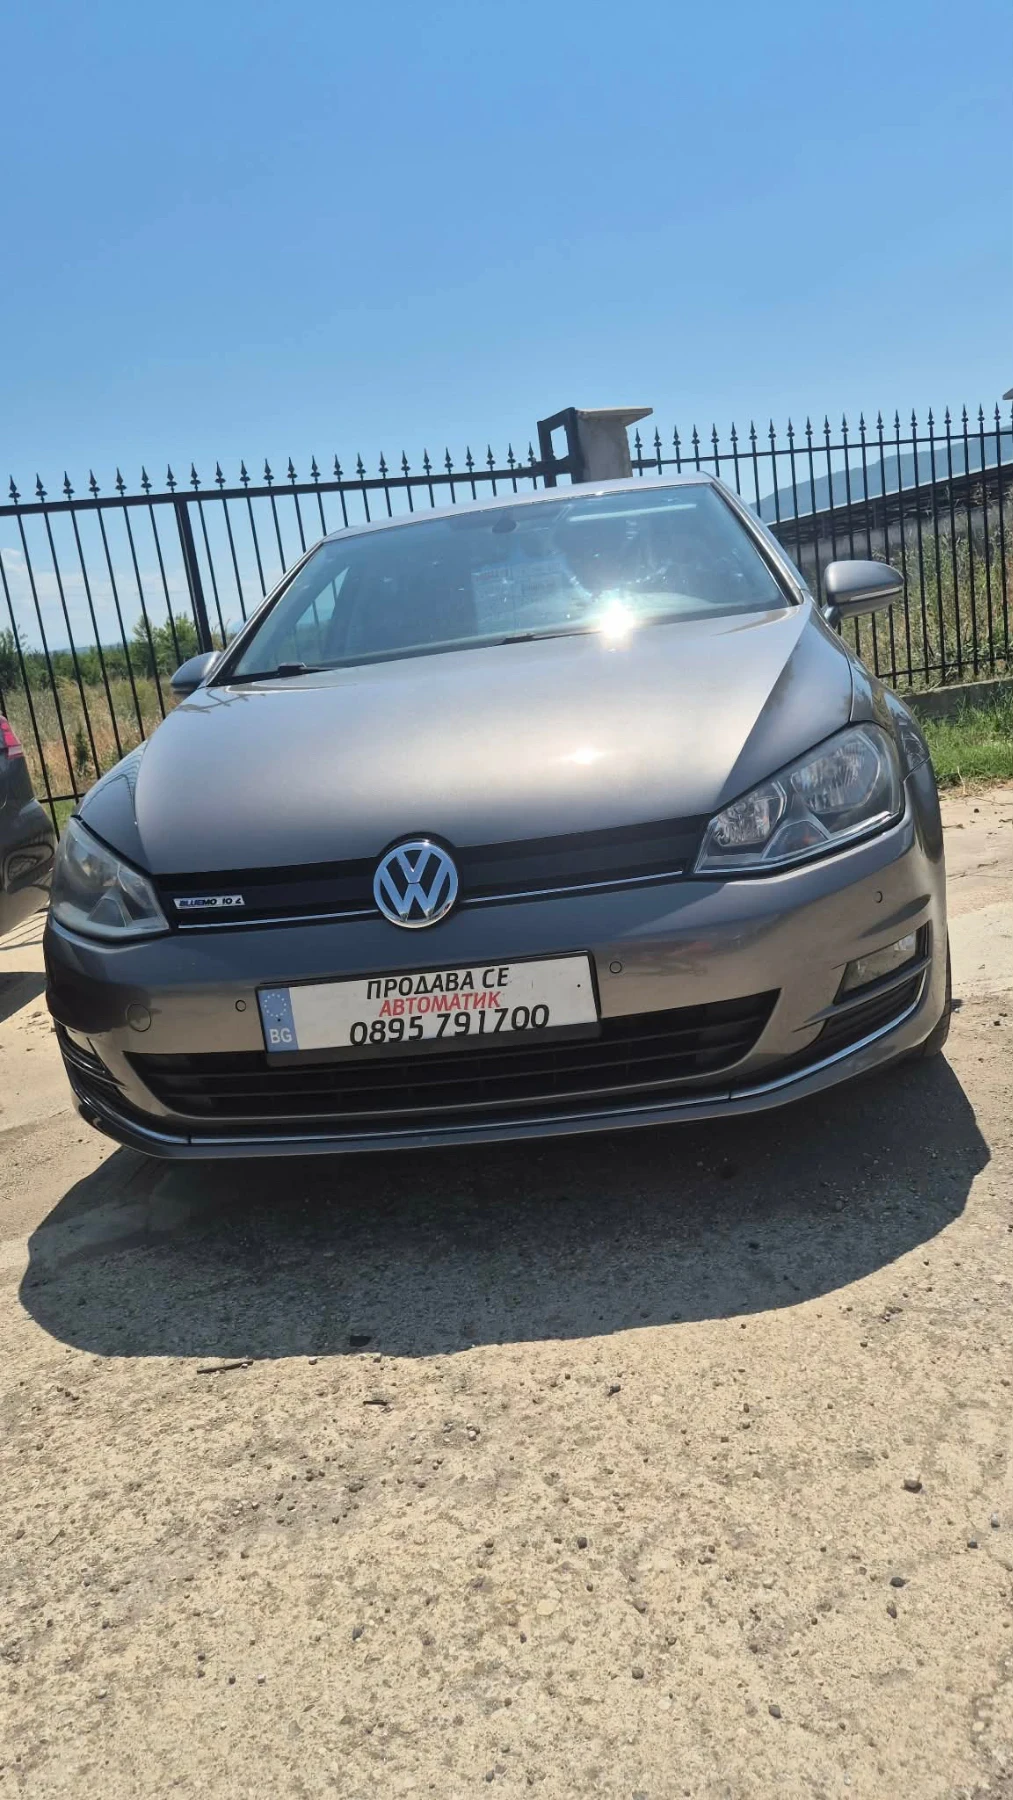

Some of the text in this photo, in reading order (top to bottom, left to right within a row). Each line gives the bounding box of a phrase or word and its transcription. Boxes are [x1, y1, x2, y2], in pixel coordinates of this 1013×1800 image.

[374, 841, 459, 928] VW
[366, 967, 510, 1000] ПРОДАВА СЕ
[379, 991, 502, 1018] АВТОМАТИК
[270, 1027, 293, 1045] BG
[349, 1004, 551, 1047] 0895 791700
